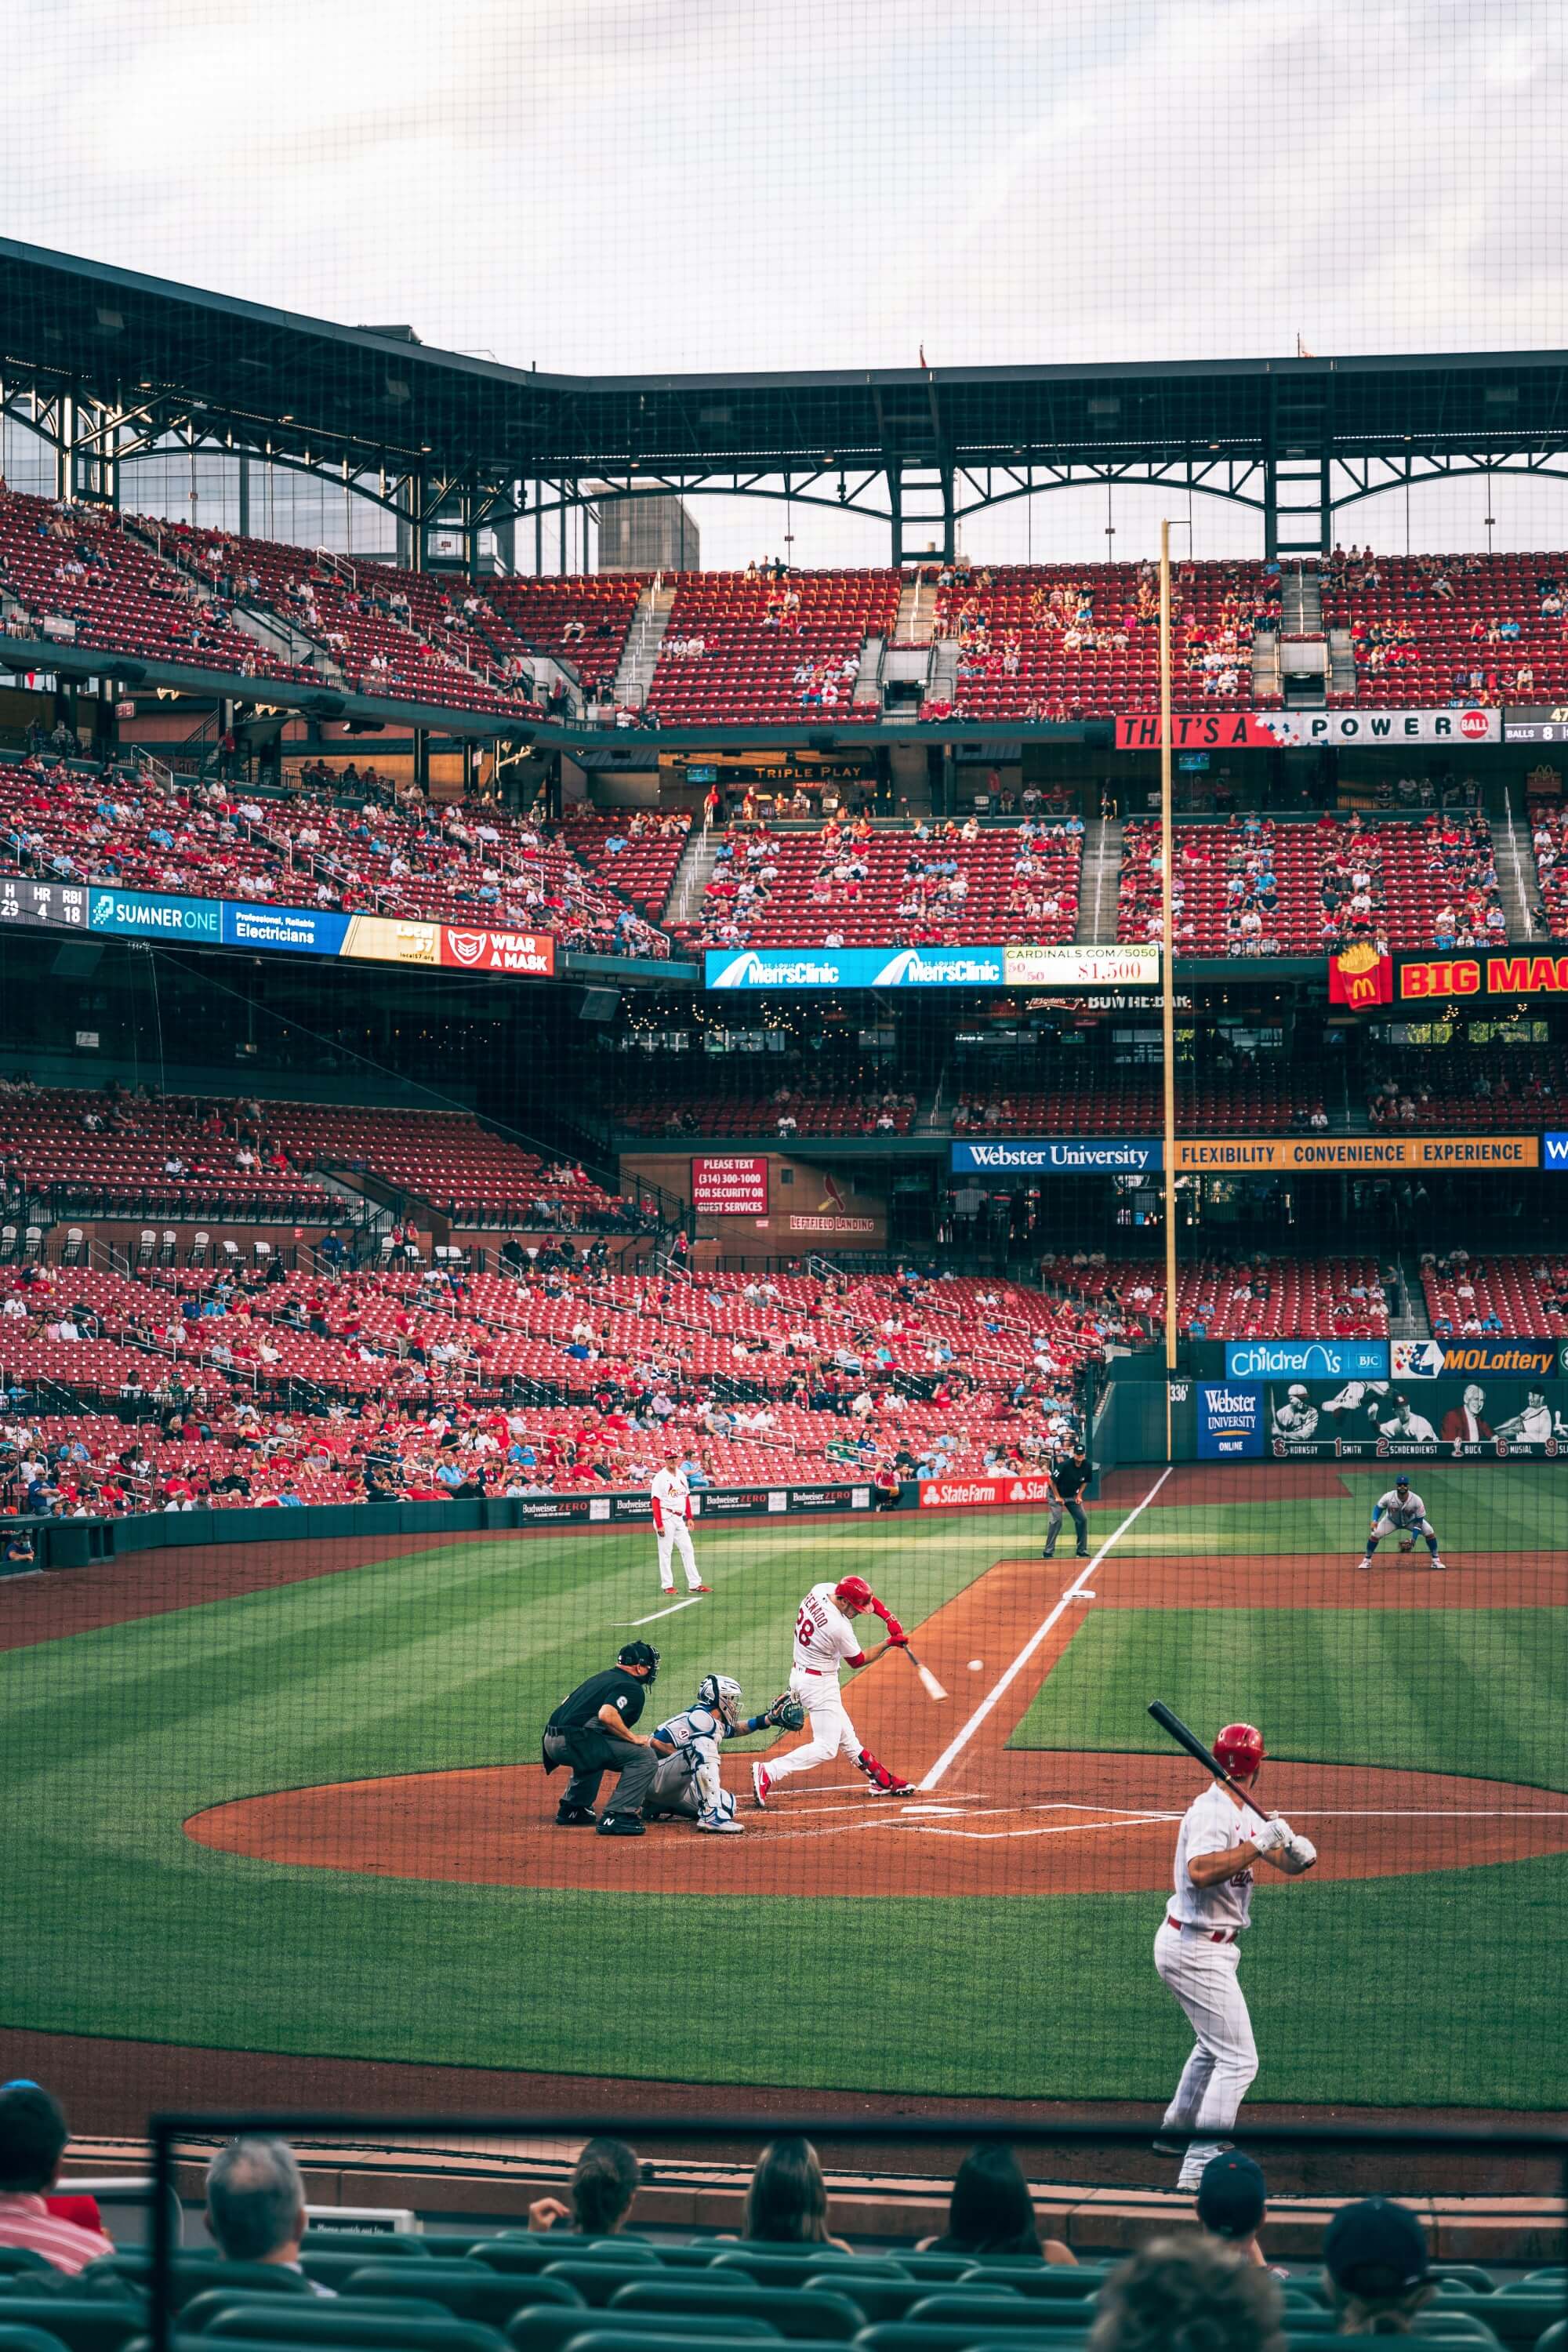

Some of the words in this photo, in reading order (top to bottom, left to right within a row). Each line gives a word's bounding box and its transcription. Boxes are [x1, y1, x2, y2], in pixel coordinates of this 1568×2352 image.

[1232, 717, 1247, 742] A
[1461, 718, 1488, 731] BALL
[1507, 729, 1534, 738] BALLS
[1543, 726, 1553, 740] 8
[755, 767, 811, 779] TRIPLE
[821, 766, 861, 777] PLAY
[5, 884, 15, 898] H
[34, 887, 50, 902] HR
[63, 890, 82, 905] RBI
[38, 903, 47, 919] 4
[64, 906, 81, 923] 18
[236, 923, 314, 944] Electricians
[396, 924, 433, 939] Local
[415, 938, 434, 952] 57
[490, 934, 535, 953] WEAR
[1007, 948, 1156, 958] CARDINALS.COM/5050
[490, 952, 503, 967] A
[504, 953, 547, 971] MASK
[1078, 962, 1141, 981] $1,500
[1401, 960, 1480, 1000] BIG
[969, 1145, 1046, 1166] Webster
[1050, 1145, 1149, 1169] University
[1181, 1146, 1275, 1163] FLEXIBILITY
[1294, 1145, 1406, 1163] CONVENIENCE
[1424, 1144, 1523, 1161] EXPERIENCE
[704, 1160, 733, 1169] PLEASE
[735, 1160, 754, 1169] TEXT
[699, 1174, 720, 1185] (314)
[722, 1174, 760, 1184] 300-1000
[695, 1188, 710, 1197] FOR
[712, 1188, 750, 1197] SECURITY
[752, 1188, 764, 1197] OR
[698, 1202, 723, 1212] GUEST
[724, 1202, 763, 1212] SERVICES
[835, 1217, 874, 1231] LANDING
[1232, 1345, 1341, 1376] Children's
[1359, 1356, 1379, 1367] BJC
[1204, 1388, 1256, 1414] Webster
[1207, 1415, 1256, 1430] UNIVERSITY
[1219, 1441, 1243, 1451] ONLINE
[1342, 1445, 1361, 1454] SMITH
[1376, 1437, 1389, 1457] 2
[1465, 1445, 1482, 1454] BUCK
[1496, 1437, 1509, 1457] 6
[1510, 1445, 1533, 1454] MUSIAL
[1545, 1437, 1558, 1457] 9
[706, 1495, 739, 1504] Budweiser
[740, 1494, 766, 1502] ZERO
[793, 1492, 824, 1501] Budweiser
[825, 1491, 851, 1500] ZERO
[522, 1504, 557, 1513] Budweiser
[558, 1502, 588, 1512] ZERO
[617, 1499, 650, 1509] Budweiser
